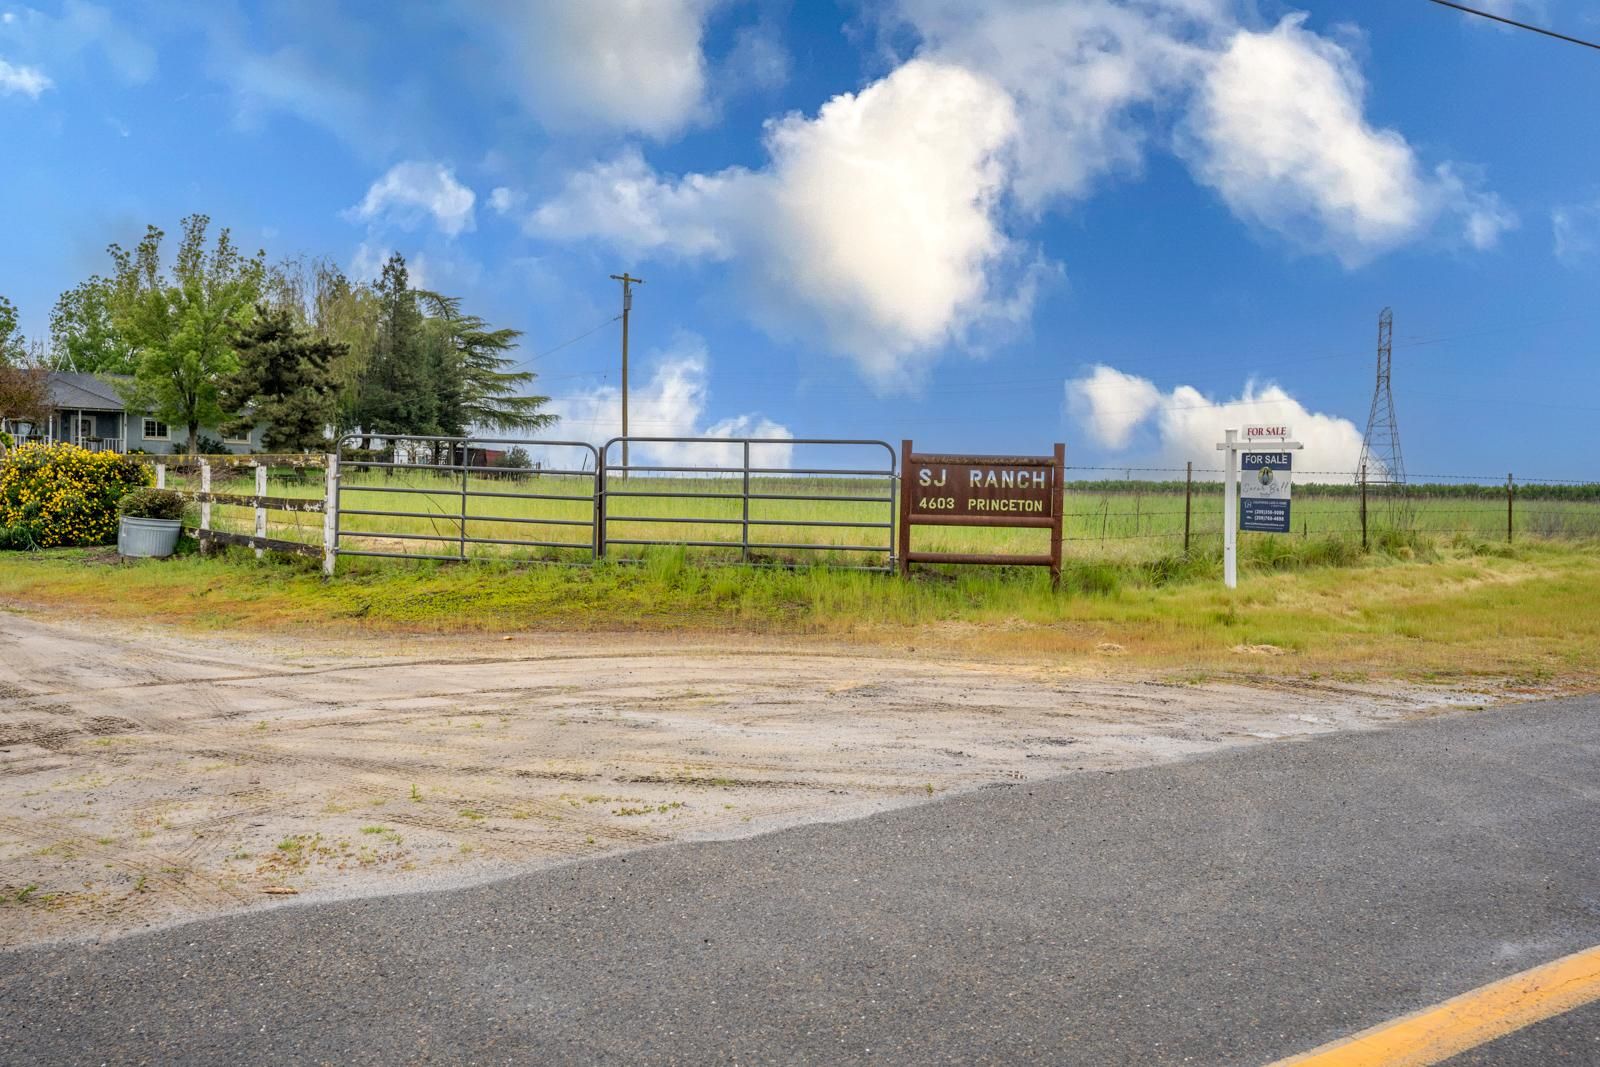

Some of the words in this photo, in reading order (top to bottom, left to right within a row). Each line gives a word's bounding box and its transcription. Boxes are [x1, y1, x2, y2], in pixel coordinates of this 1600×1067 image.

[1247, 427, 1264, 436] FOR
[1266, 426, 1287, 436] SALE
[1245, 455, 1263, 464] FOR
[1264, 455, 1288, 464] SALE
[919, 468, 946, 487] SJ
[969, 469, 1045, 489] RANCH
[919, 497, 955, 509] 4603
[968, 498, 1043, 512] PRINCETON
